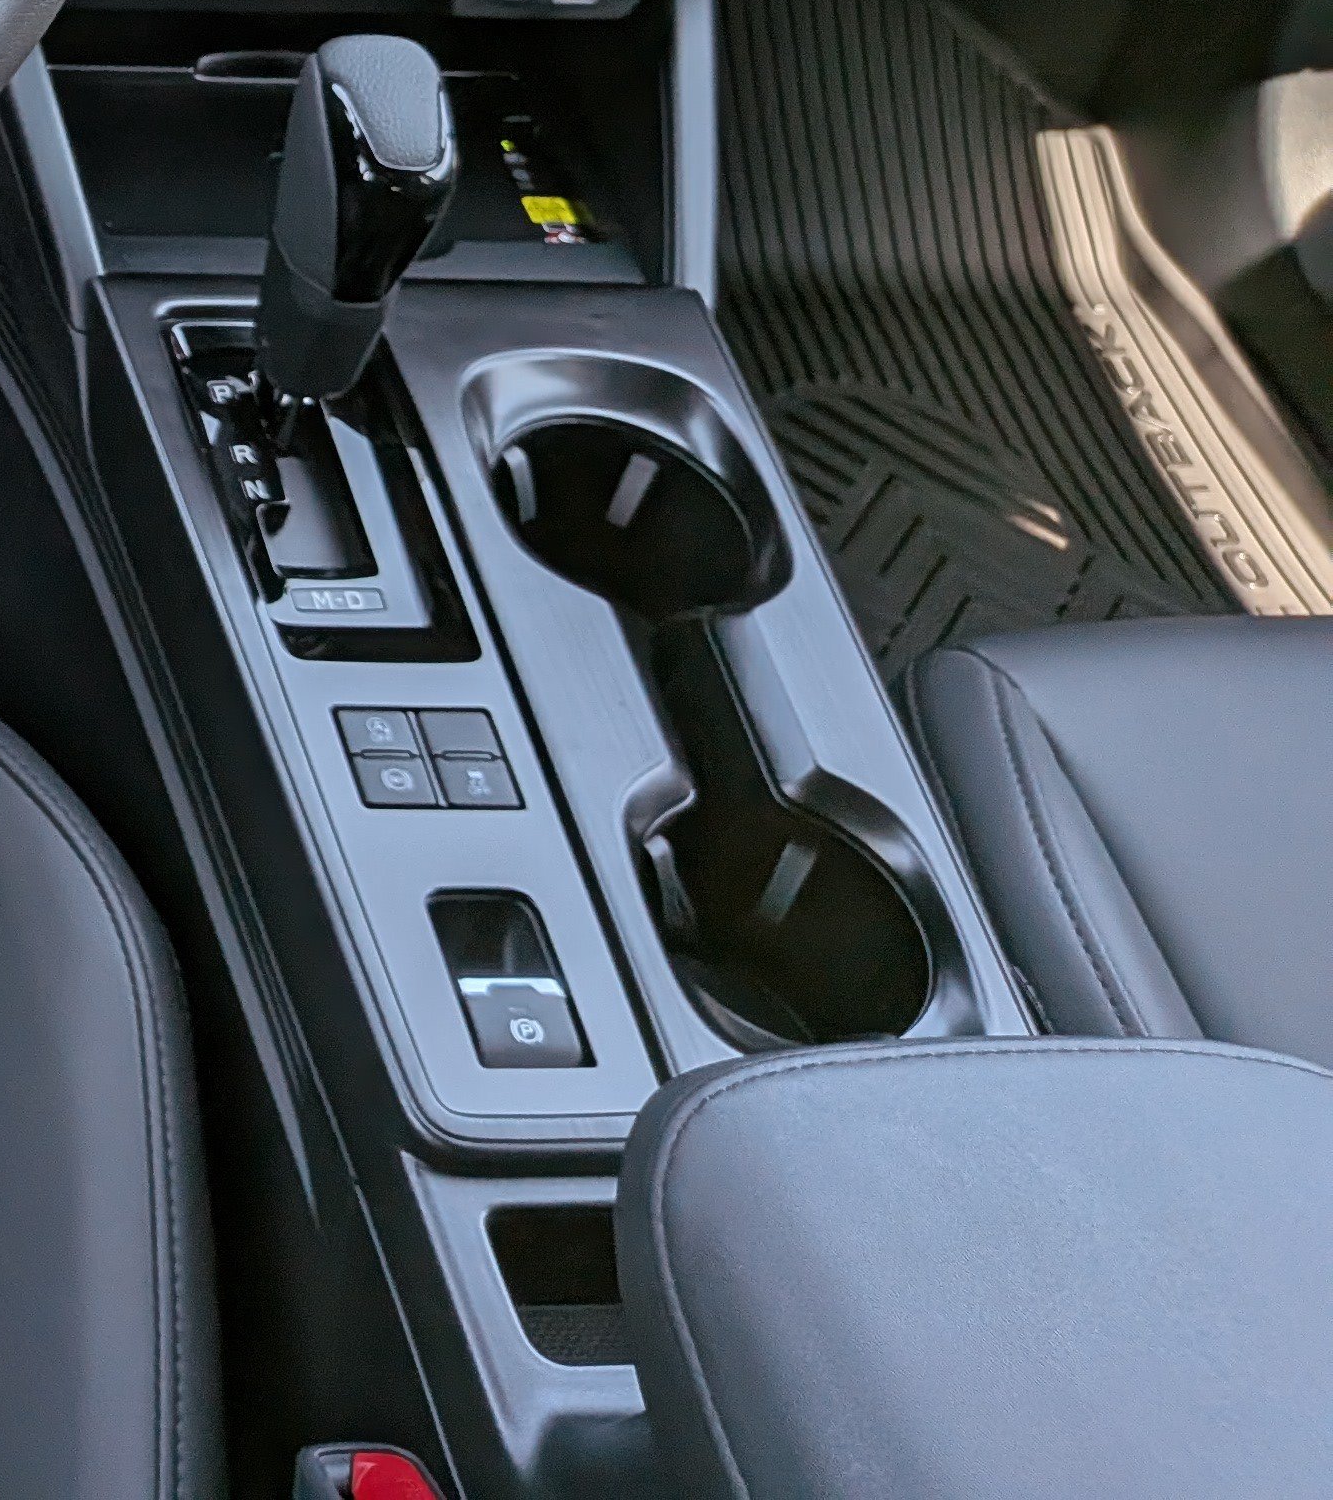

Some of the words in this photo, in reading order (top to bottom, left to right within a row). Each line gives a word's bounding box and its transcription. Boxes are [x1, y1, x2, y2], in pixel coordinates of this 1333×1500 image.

[232, 444, 259, 465] R
[1085, 323, 1269, 590] OUTBACK
[243, 479, 271, 500] N
